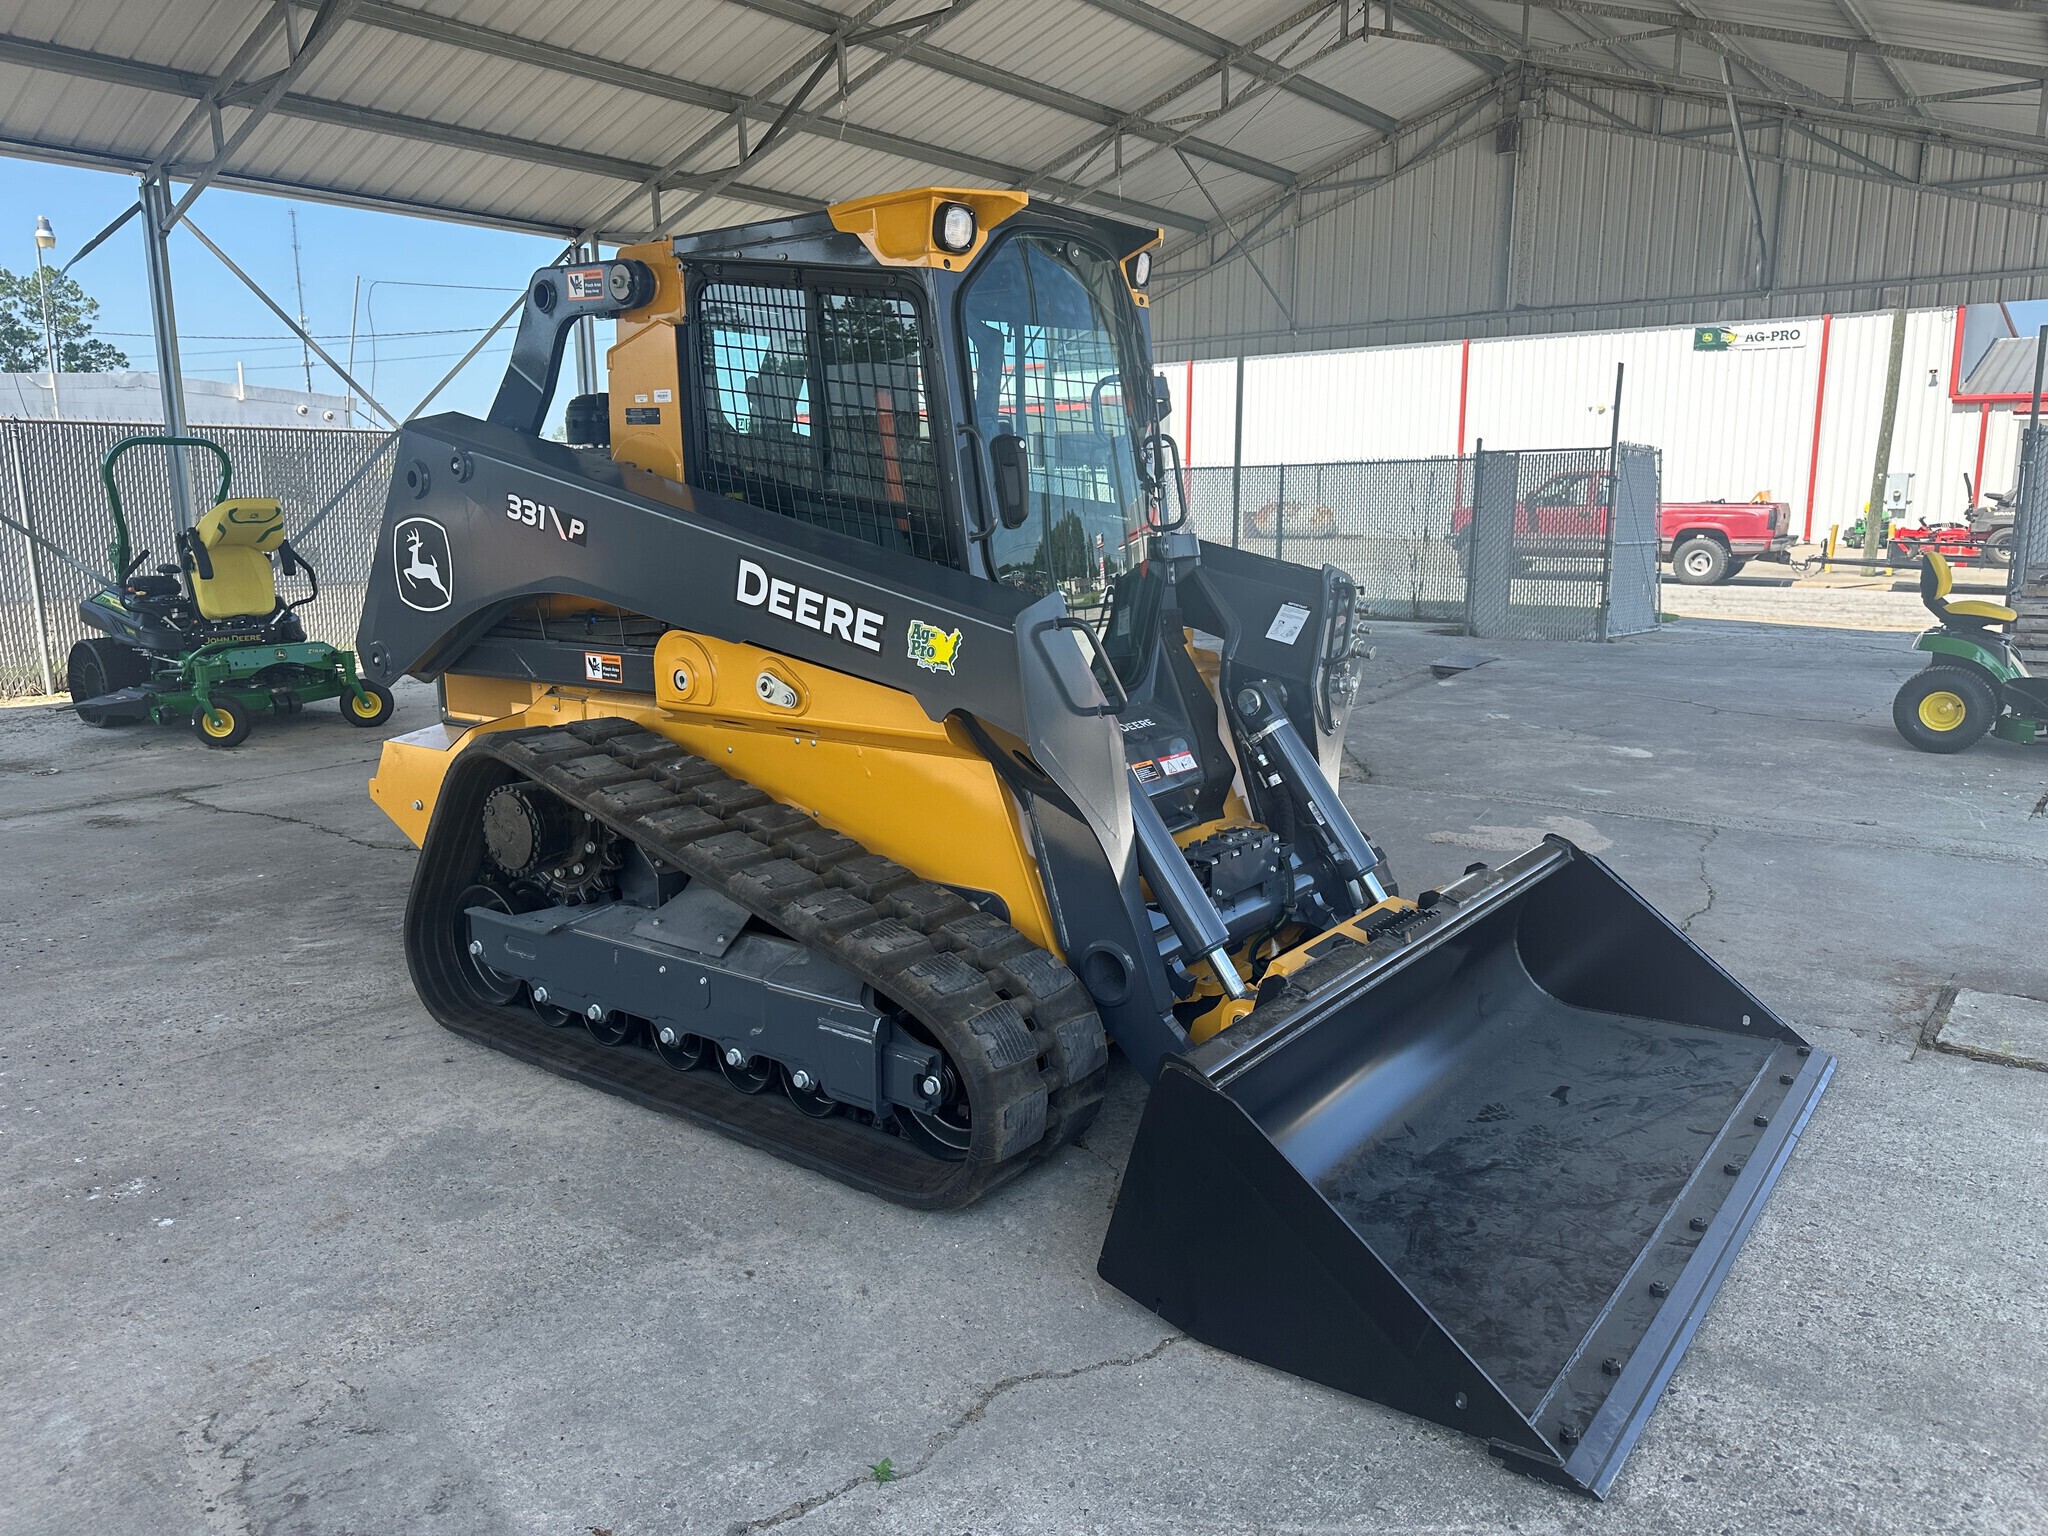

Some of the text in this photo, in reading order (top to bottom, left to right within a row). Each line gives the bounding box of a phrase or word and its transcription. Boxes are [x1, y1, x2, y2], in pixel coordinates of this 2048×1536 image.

[1745, 329, 1801, 343] AG-PRO
[506, 493, 546, 531] 331
[736, 558, 884, 653] DEERE
[910, 623, 936, 645] Ag-
[910, 639, 936, 659] Pro
[1119, 718, 1157, 733] DEERE
